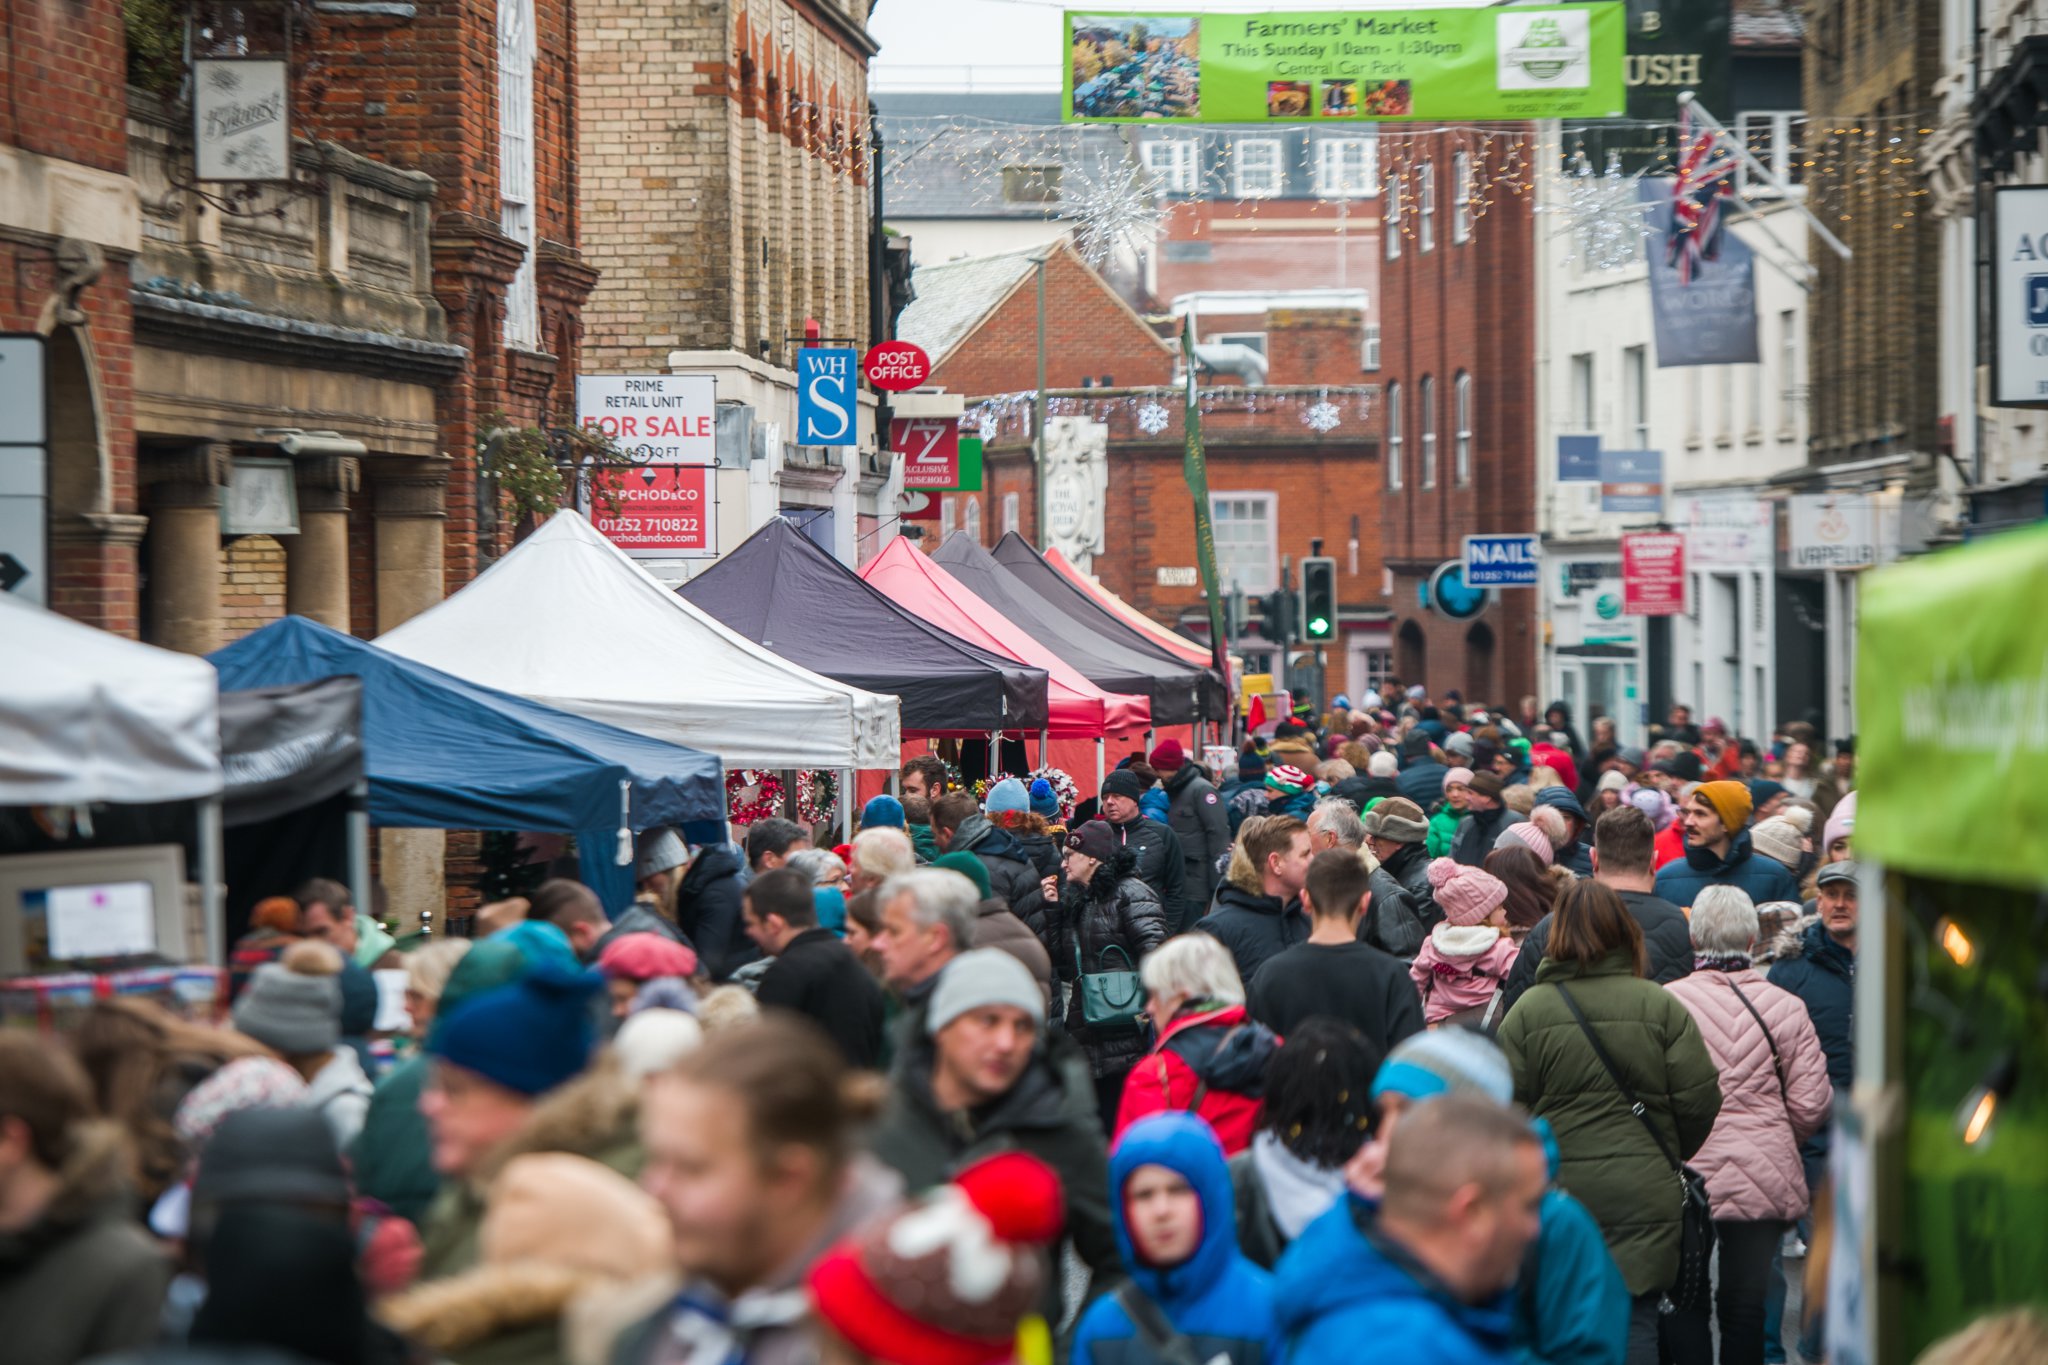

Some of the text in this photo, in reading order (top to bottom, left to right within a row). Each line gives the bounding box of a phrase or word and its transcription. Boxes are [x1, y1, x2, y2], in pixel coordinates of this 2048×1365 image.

[1245, 17, 1439, 37] Farmers' Market
[1222, 43, 1259, 57] This
[1265, 42, 1327, 58] Sunday
[1334, 41, 1380, 56] 10am
[1398, 40, 1463, 57] 1:30pm
[1275, 59, 1407, 75] Central Car Park
[1622, 54, 1703, 85] USH
[807, 356, 847, 375] WH
[878, 351, 916, 366] POST
[869, 365, 923, 380] OFFICE
[625, 380, 664, 392] PRIME
[606, 396, 684, 408] RETAIL UNIT
[807, 375, 849, 439] S
[583, 416, 711, 437] FOR SALE
[666, 447, 680, 457] FT
[905, 465, 950, 473] XCLUSIVE
[905, 475, 952, 484] OUSEHOLD
[599, 518, 699, 531] 01252 710822
[1471, 542, 1540, 564] NAILS
[1472, 570, 1503, 580] 01252
